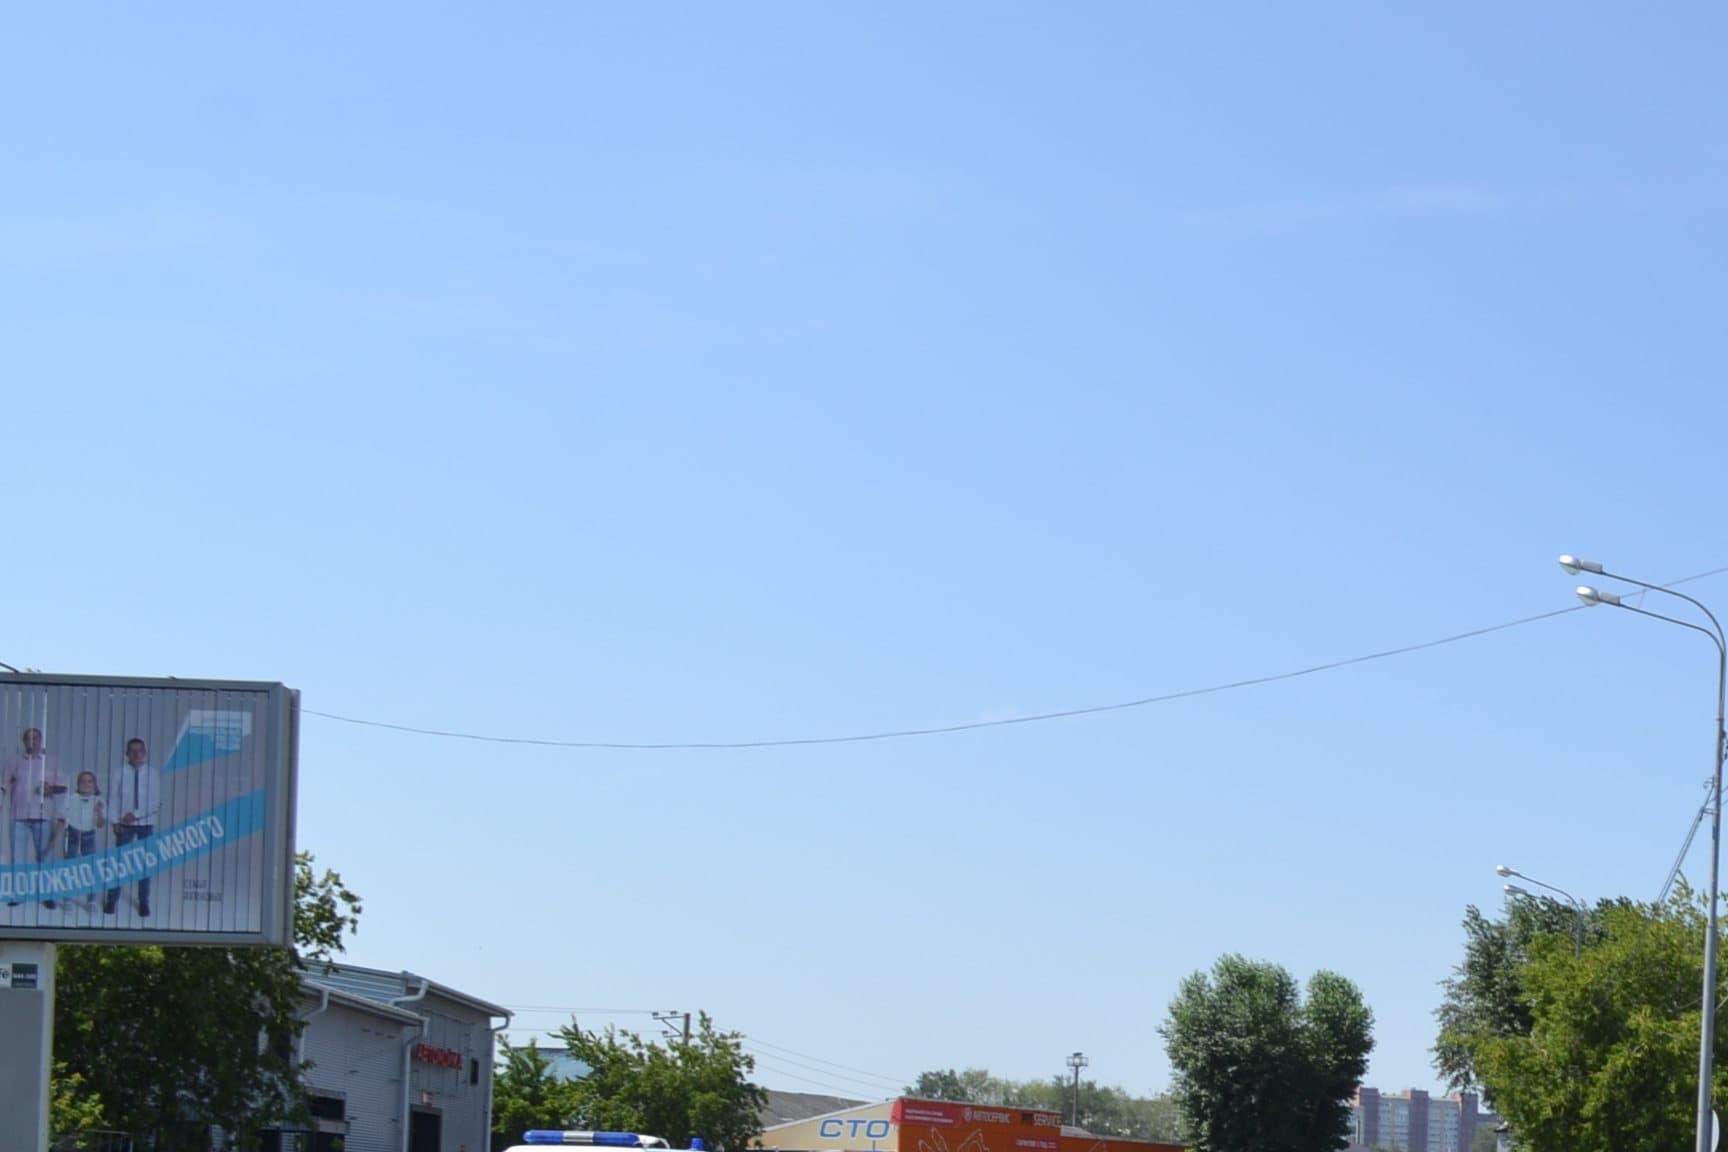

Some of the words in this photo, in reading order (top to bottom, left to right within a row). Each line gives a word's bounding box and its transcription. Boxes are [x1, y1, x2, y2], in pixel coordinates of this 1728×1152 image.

[0, 864, 95, 898] ДОЛЖНО
[97, 846, 158, 882] БЫТЬ
[156, 815, 224, 862] МНОГО
[819, 1119, 891, 1139] СТО
